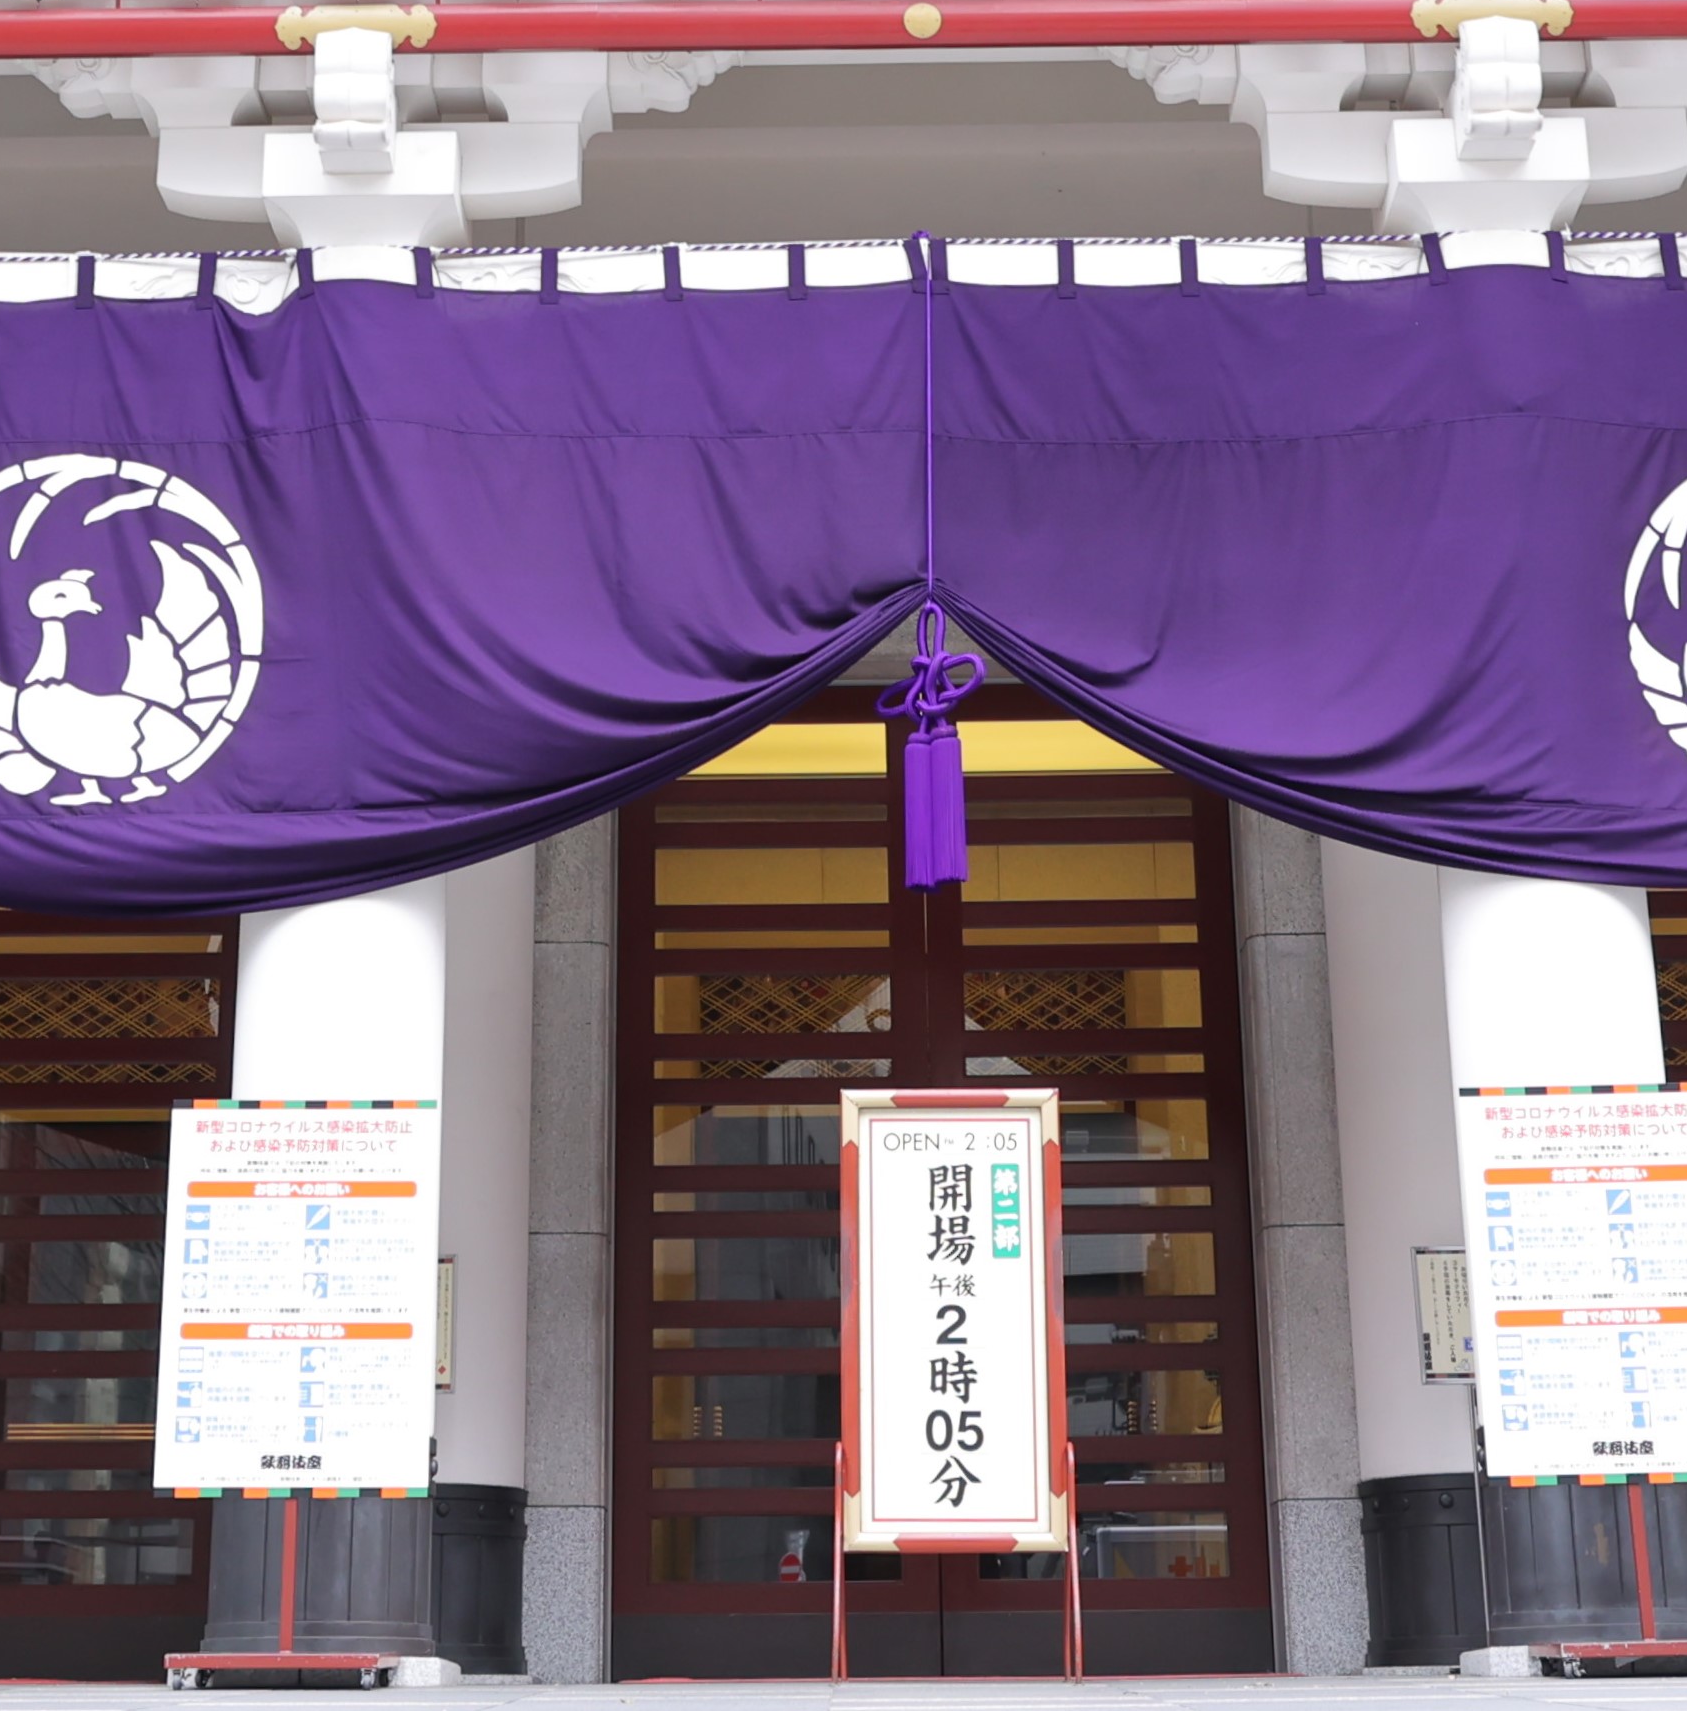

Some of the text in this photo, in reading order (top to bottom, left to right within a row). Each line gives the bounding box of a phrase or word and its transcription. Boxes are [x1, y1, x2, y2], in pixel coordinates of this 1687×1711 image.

[195, 1120, 414, 1135] 新型コロナウイルス感染拡大防止
[209, 1139, 397, 1153] および感染予防対策について
[883, 1132, 940, 1152] OPEN
[993, 1167, 1020, 1252] 第二部
